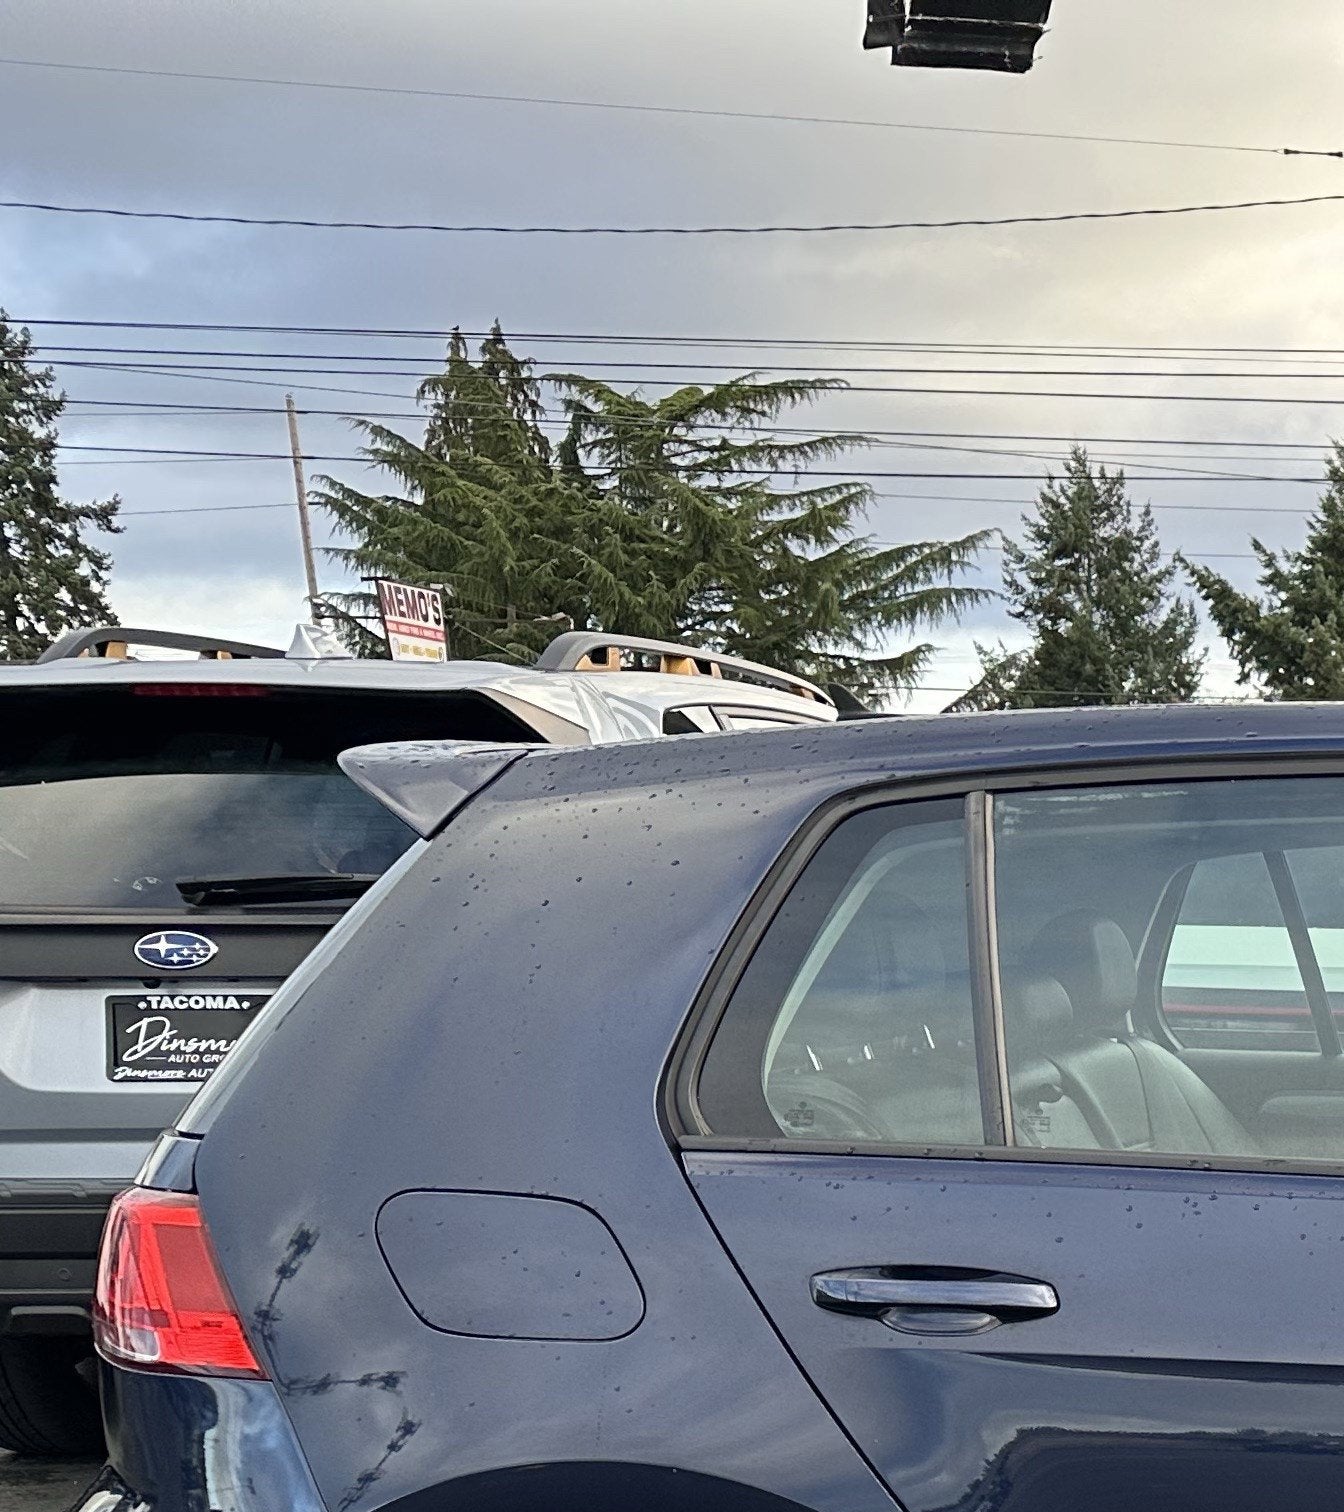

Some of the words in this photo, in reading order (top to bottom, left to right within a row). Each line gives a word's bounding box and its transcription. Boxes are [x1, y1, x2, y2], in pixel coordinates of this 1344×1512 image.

[146, 996, 241, 1010] TACOMA
[122, 1016, 237, 1062] Dinsm
[168, 1054, 199, 1063] AUTO
